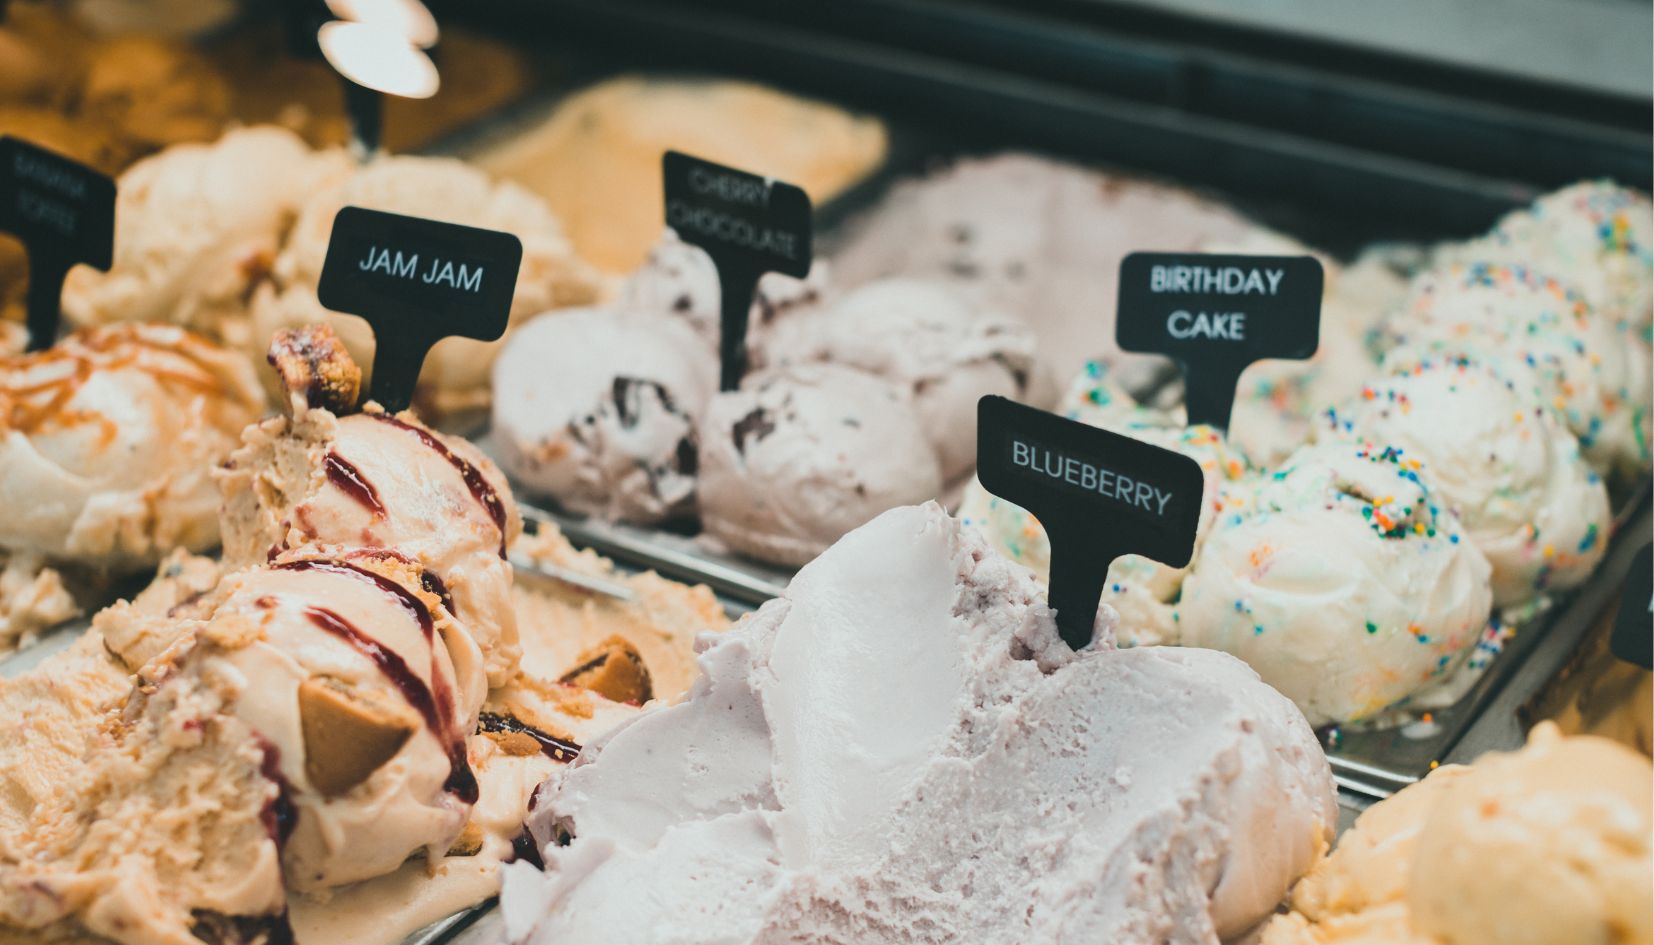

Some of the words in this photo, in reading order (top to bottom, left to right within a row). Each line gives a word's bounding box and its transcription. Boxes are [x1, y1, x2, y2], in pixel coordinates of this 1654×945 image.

[691, 168, 770, 203] CHERRY
[668, 202, 797, 260] CHOCOLATE
[359, 246, 419, 279] JAM
[422, 258, 484, 293] JAM
[1150, 264, 1284, 295] BIRTHDAY
[1166, 309, 1246, 341] CAKE
[1012, 441, 1172, 516] BLUEBERRY
